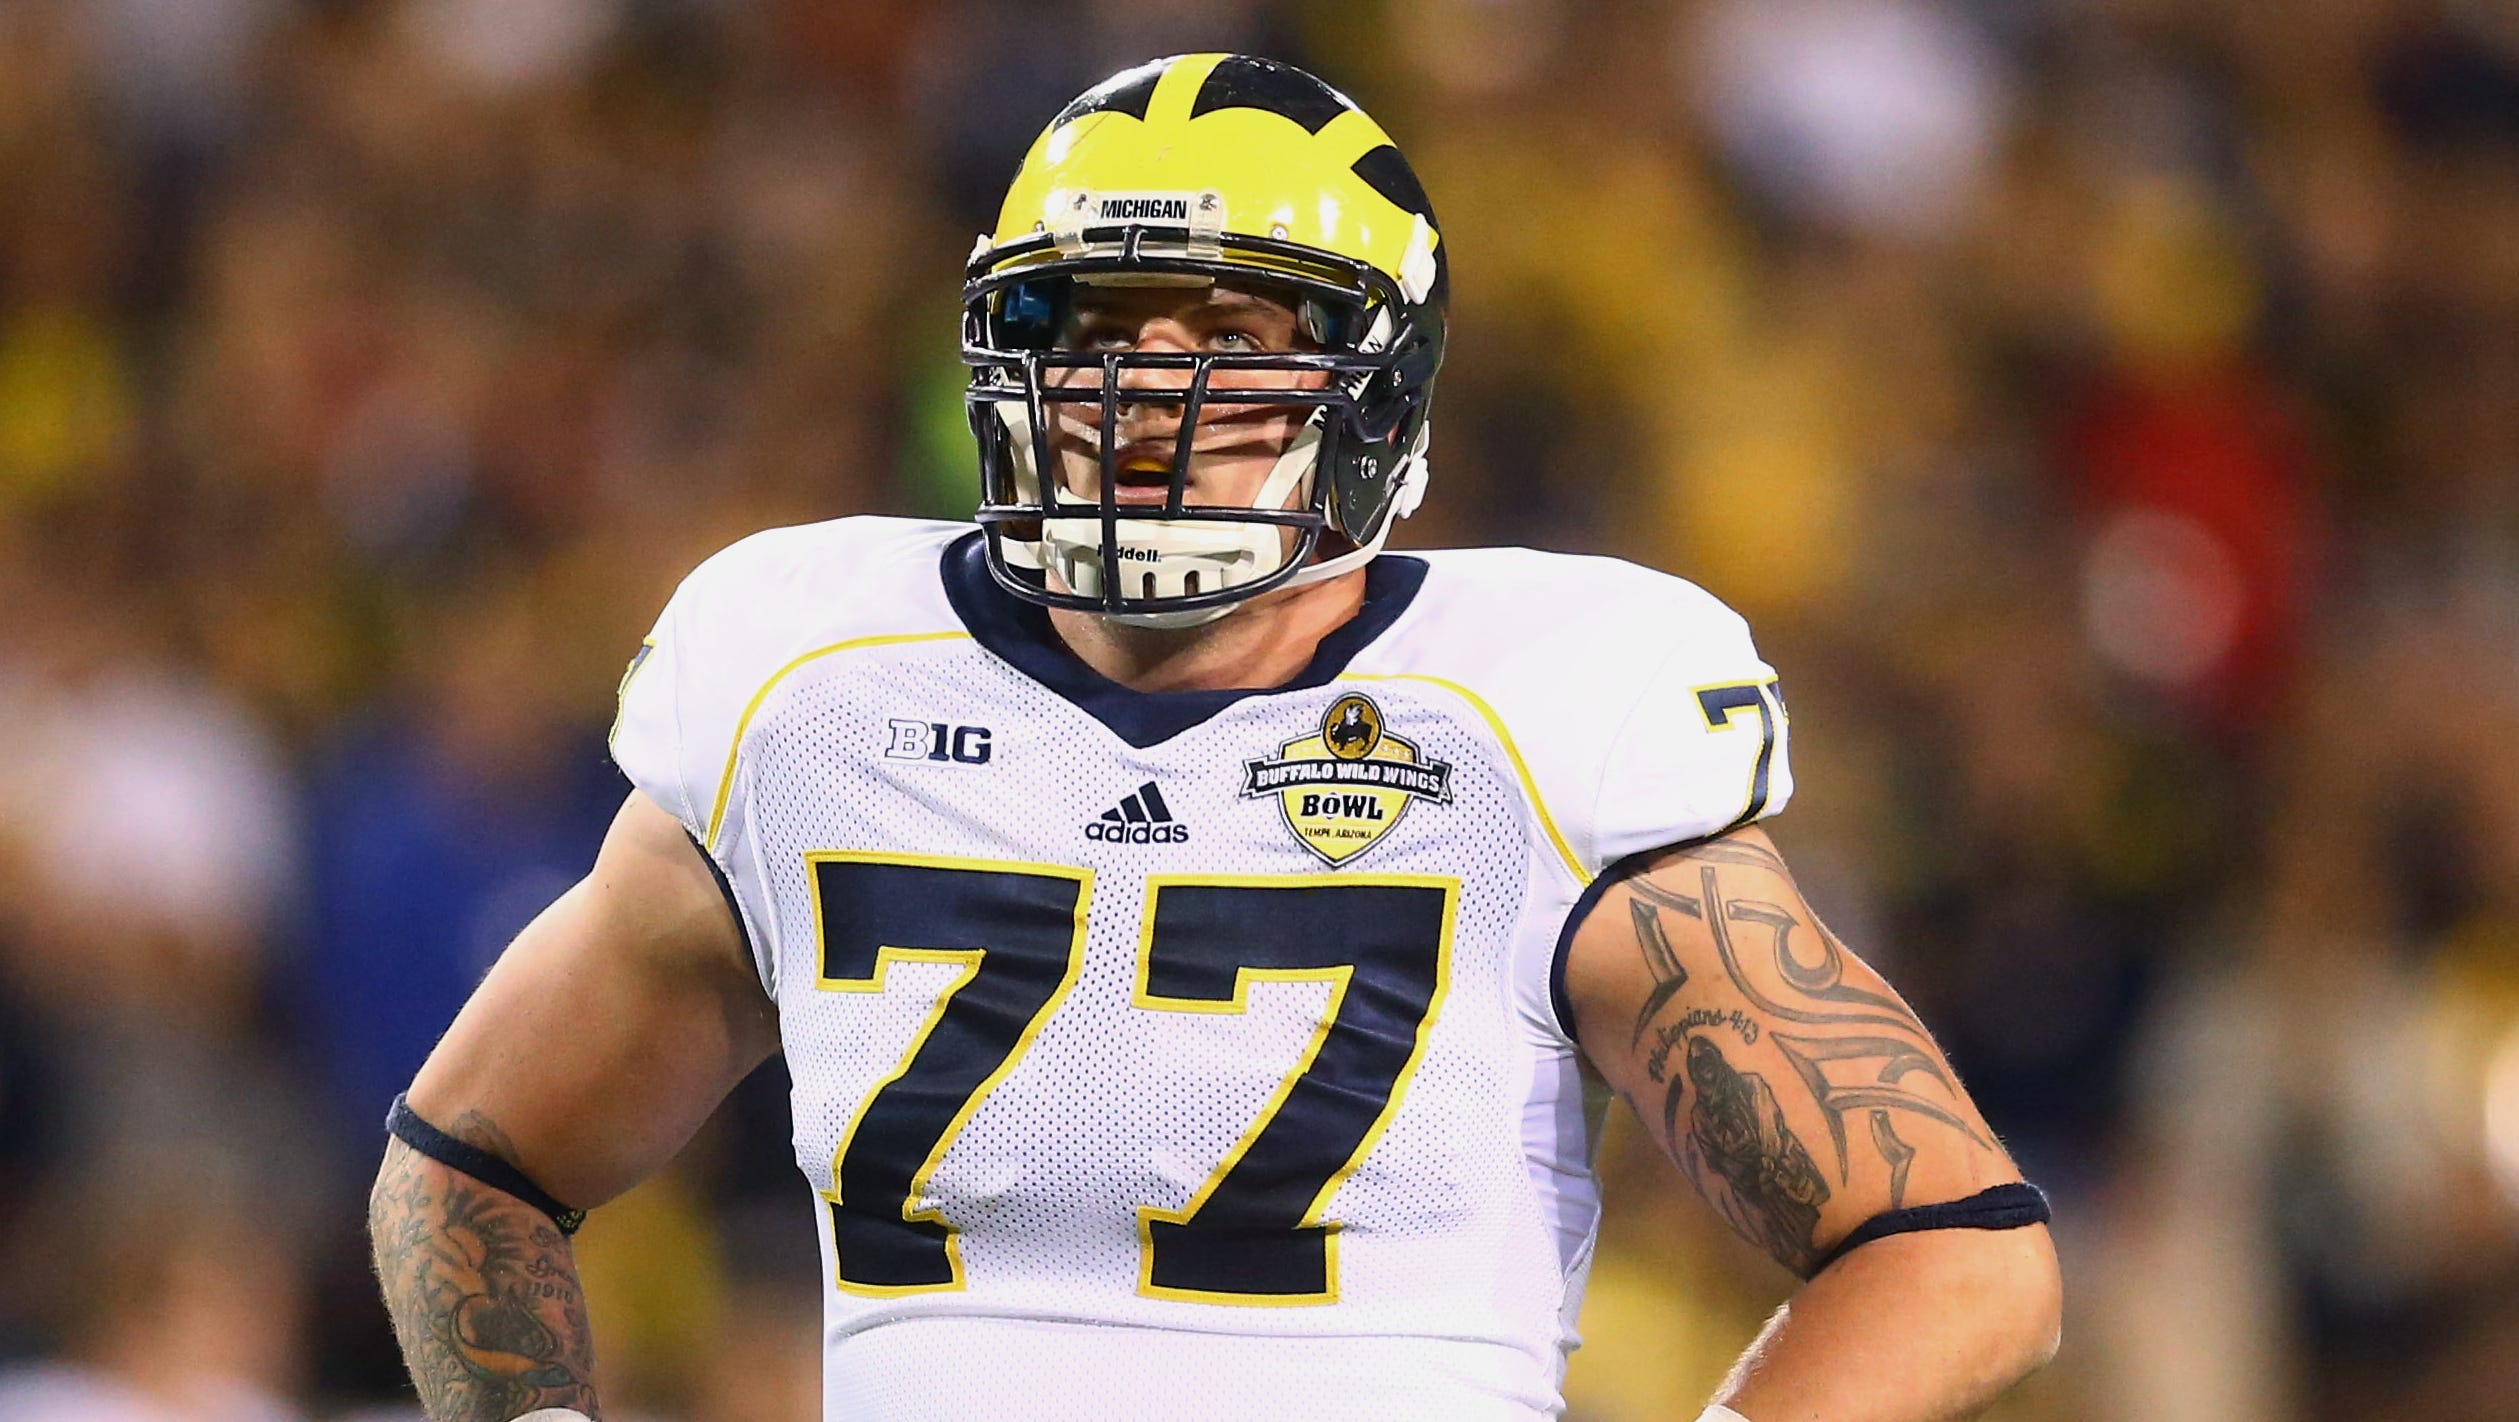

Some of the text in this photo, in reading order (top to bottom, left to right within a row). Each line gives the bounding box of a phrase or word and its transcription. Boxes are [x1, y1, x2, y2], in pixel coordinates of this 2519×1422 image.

[1100, 199, 1187, 219] MICHIGAN
[1256, 762, 1440, 792] BUFFALO WILD WINGS
[1301, 793, 1384, 820] BOWL
[1084, 820, 1189, 844] adidas
[1336, 828, 1372, 839] ARIZONA
[804, 850, 1462, 1304] 77
